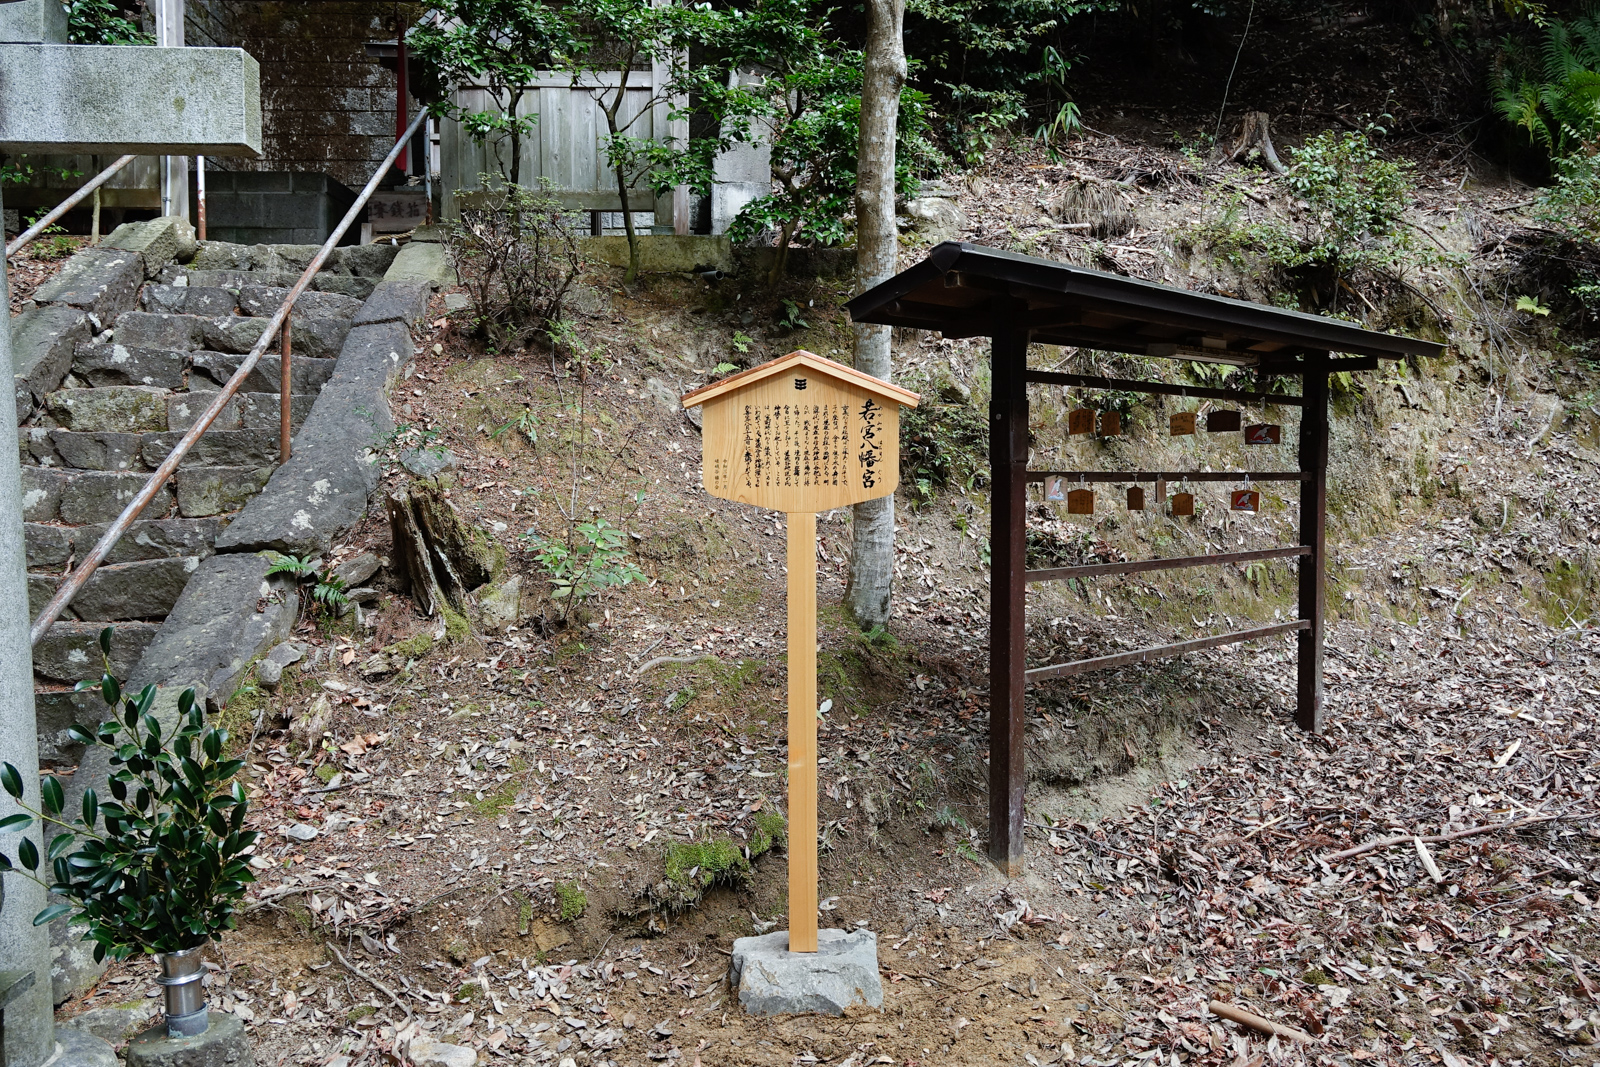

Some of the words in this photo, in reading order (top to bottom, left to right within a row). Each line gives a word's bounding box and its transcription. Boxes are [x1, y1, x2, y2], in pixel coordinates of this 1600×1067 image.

[858, 398, 879, 489] 若宮八幡宮
